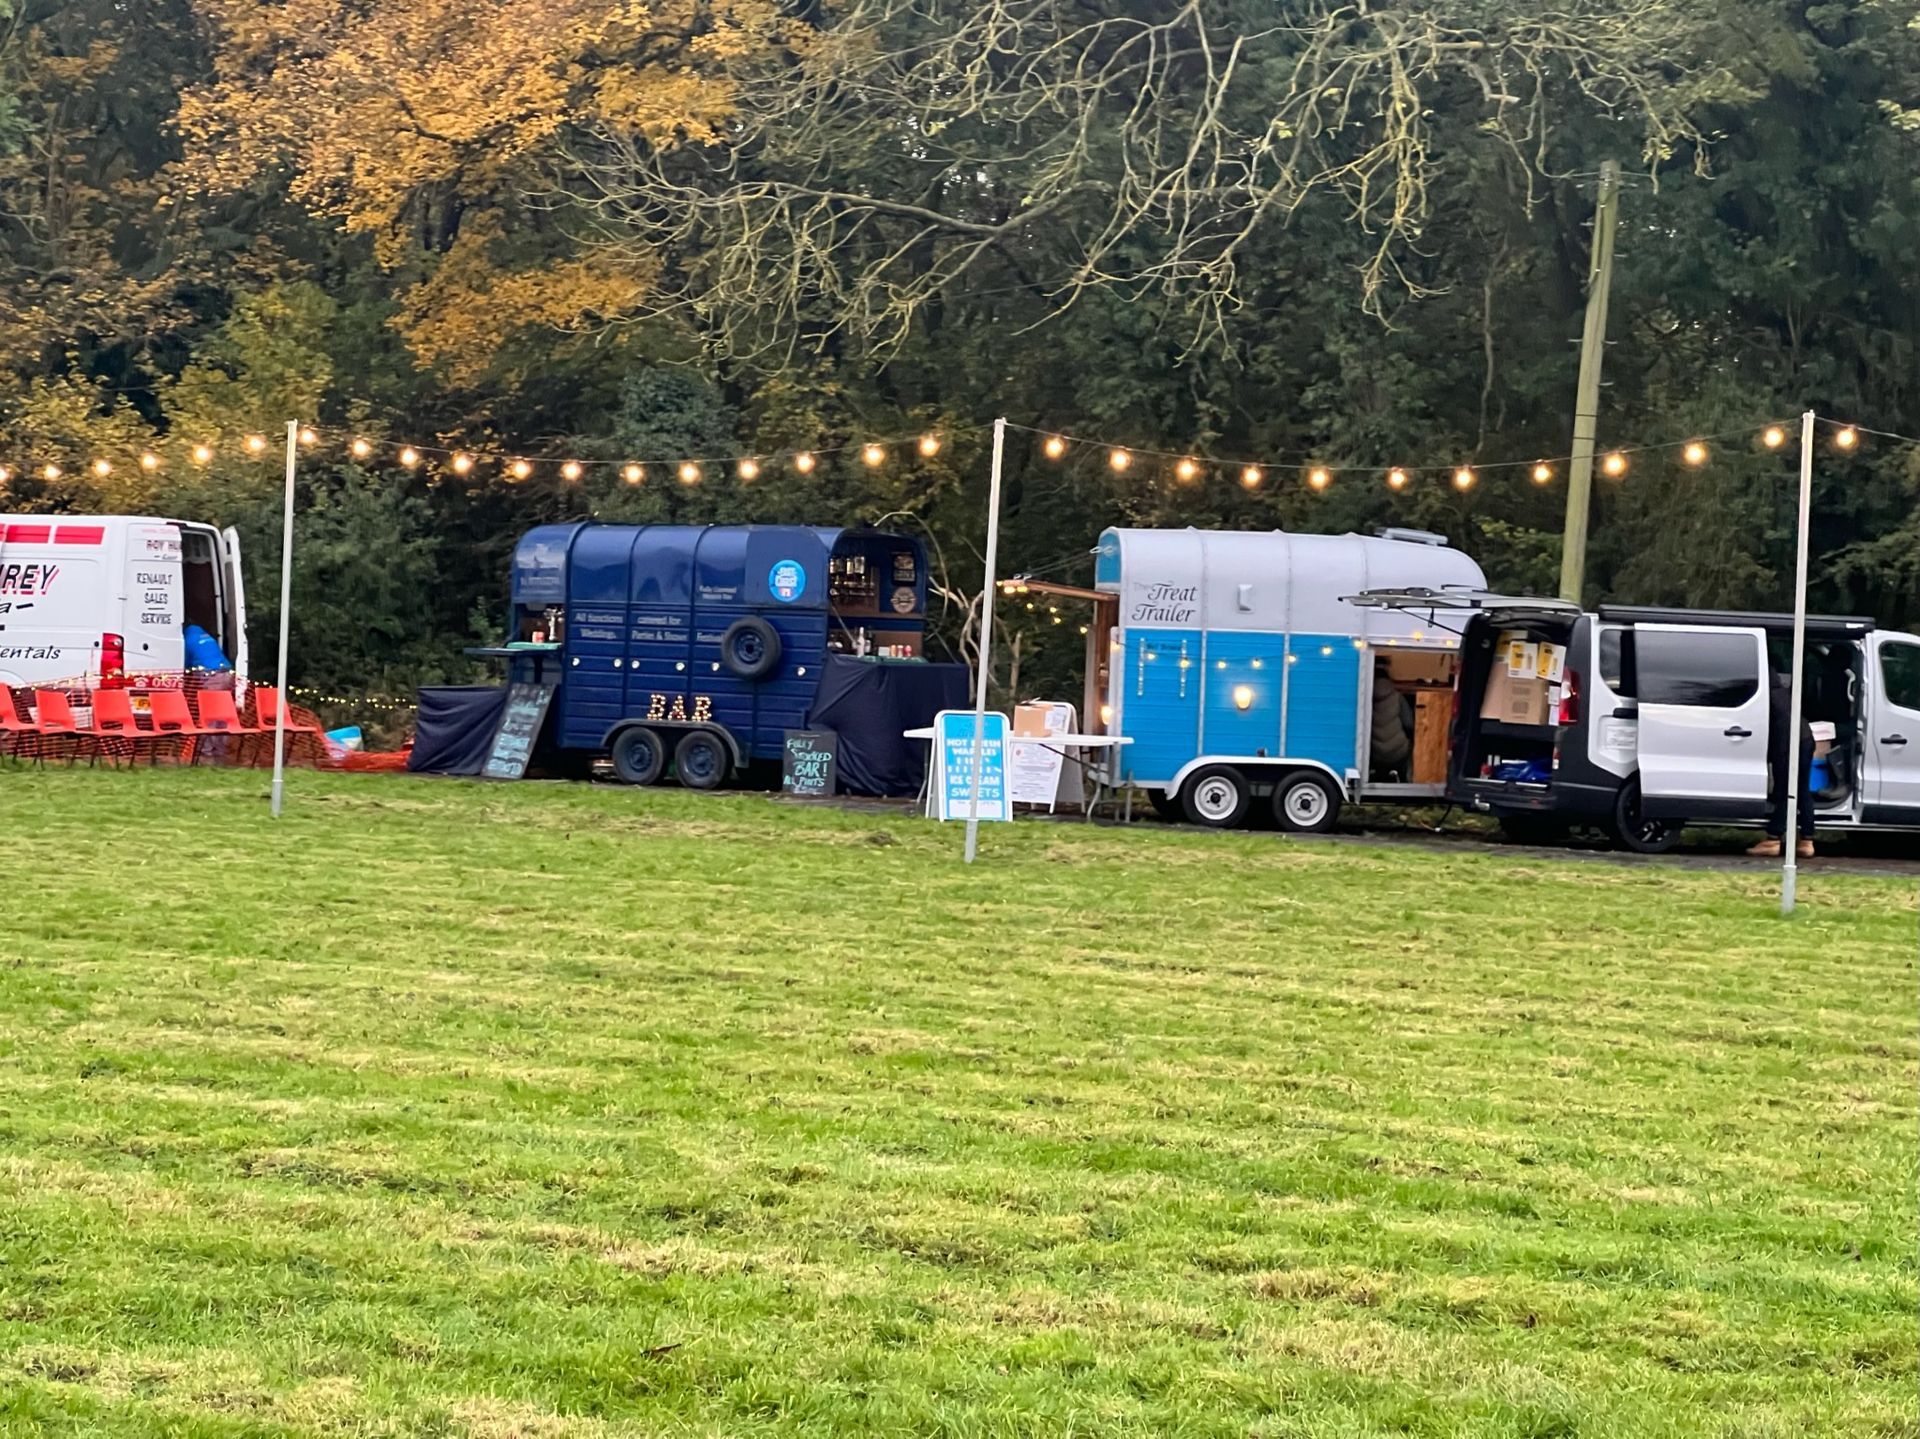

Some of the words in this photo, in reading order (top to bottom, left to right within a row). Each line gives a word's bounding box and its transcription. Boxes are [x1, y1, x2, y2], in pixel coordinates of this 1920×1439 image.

[137, 573, 172, 584] RENAULT
[1147, 581, 1198, 601] Treat
[144, 593, 168, 604] SALES
[1131, 602, 1196, 622] Trailer
[141, 613, 172, 624] SERVICE
[0, 645, 61, 659] entals
[647, 694, 712, 722] BAR
[947, 739, 967, 747] HOT
[965, 775, 1000, 785] CEAM
[951, 787, 1000, 798] SWETS
